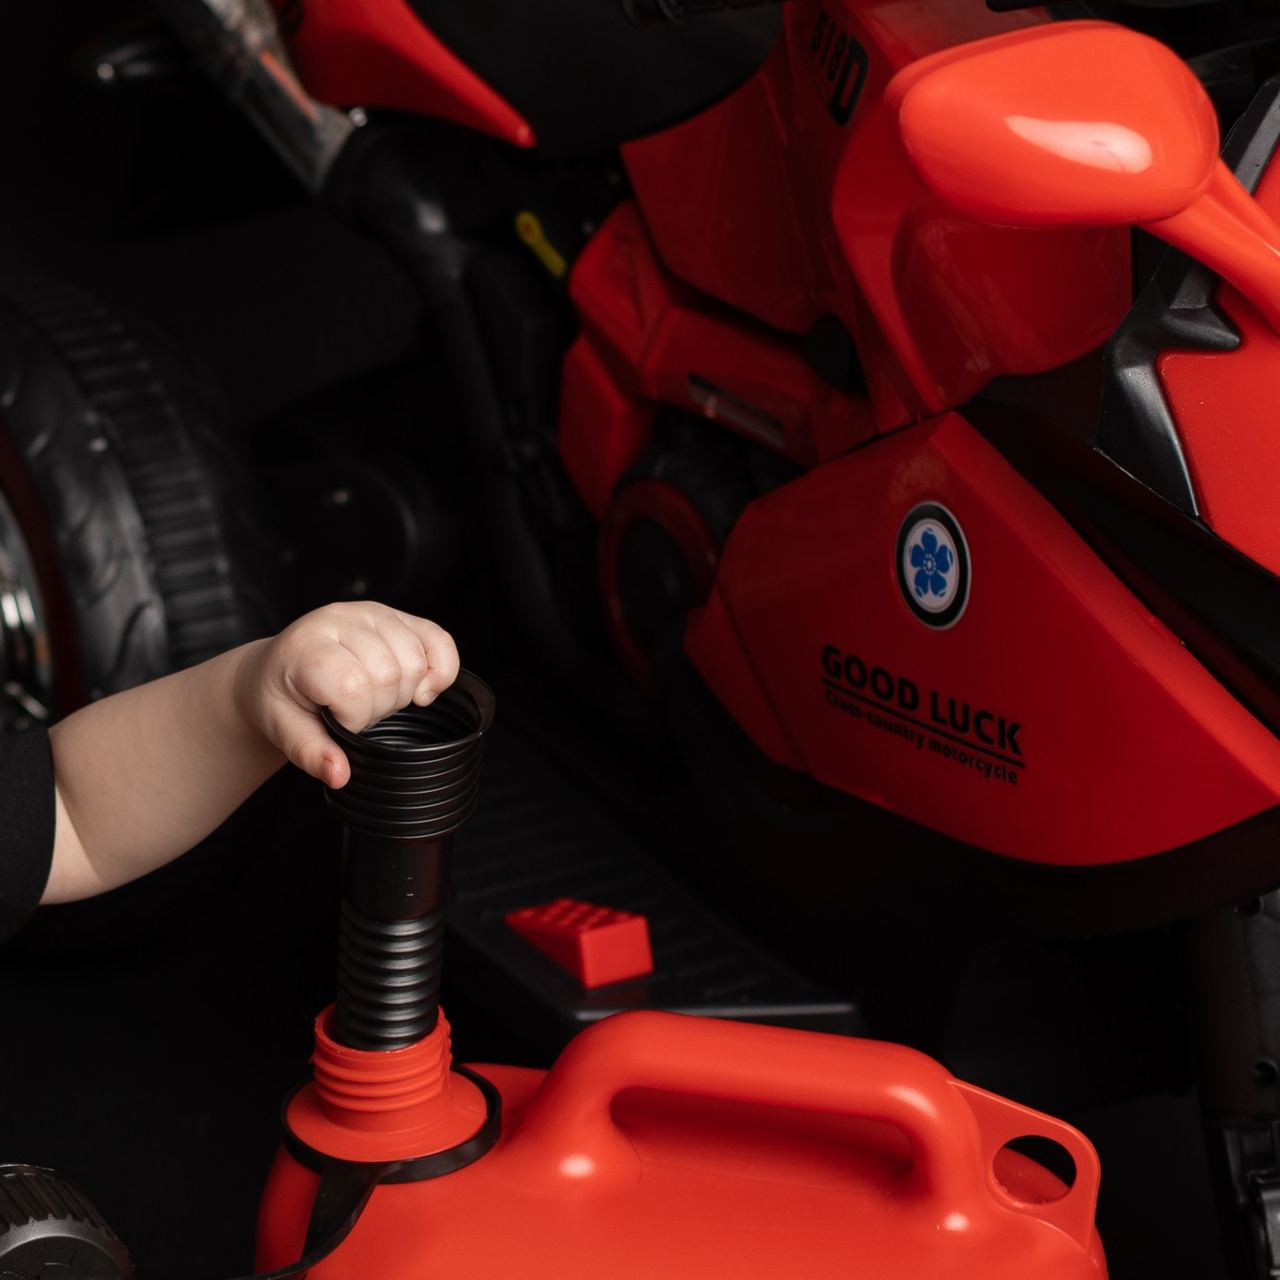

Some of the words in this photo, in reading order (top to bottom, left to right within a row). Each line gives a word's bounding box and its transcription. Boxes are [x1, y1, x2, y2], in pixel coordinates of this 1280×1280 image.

[821, 645, 920, 713] GOOD
[930, 689, 1023, 756] LUCK
[824, 687, 925, 750] Cross-country
[928, 735, 1019, 786] motorcycle
